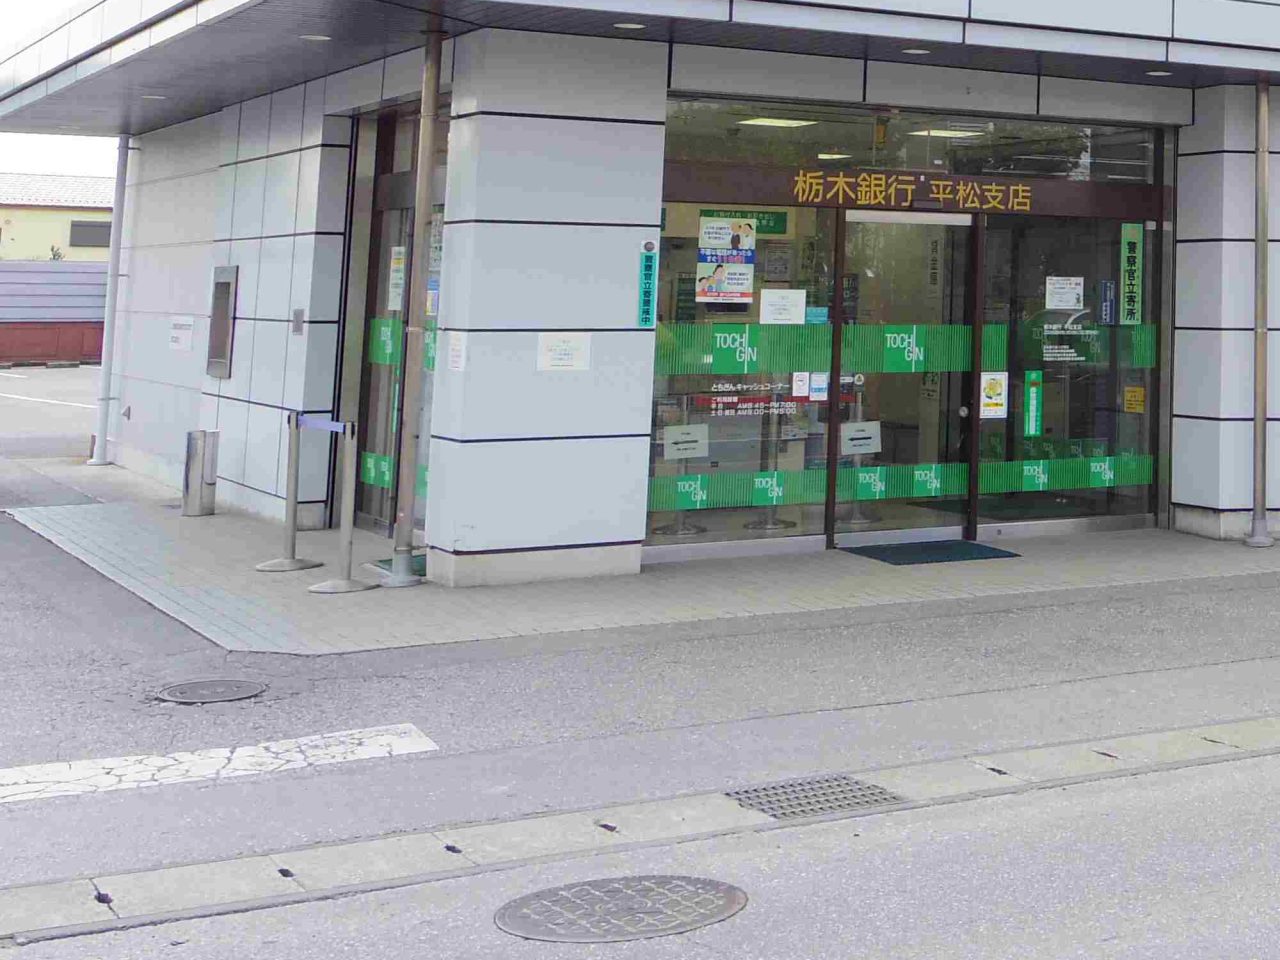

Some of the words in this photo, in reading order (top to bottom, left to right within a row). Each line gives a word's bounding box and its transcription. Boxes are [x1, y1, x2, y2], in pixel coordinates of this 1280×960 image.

[793, 170, 916, 208] 栃木銀行
[929, 180, 1032, 211] 平松支店
[1126, 241, 1138, 321] 警察官立寄所
